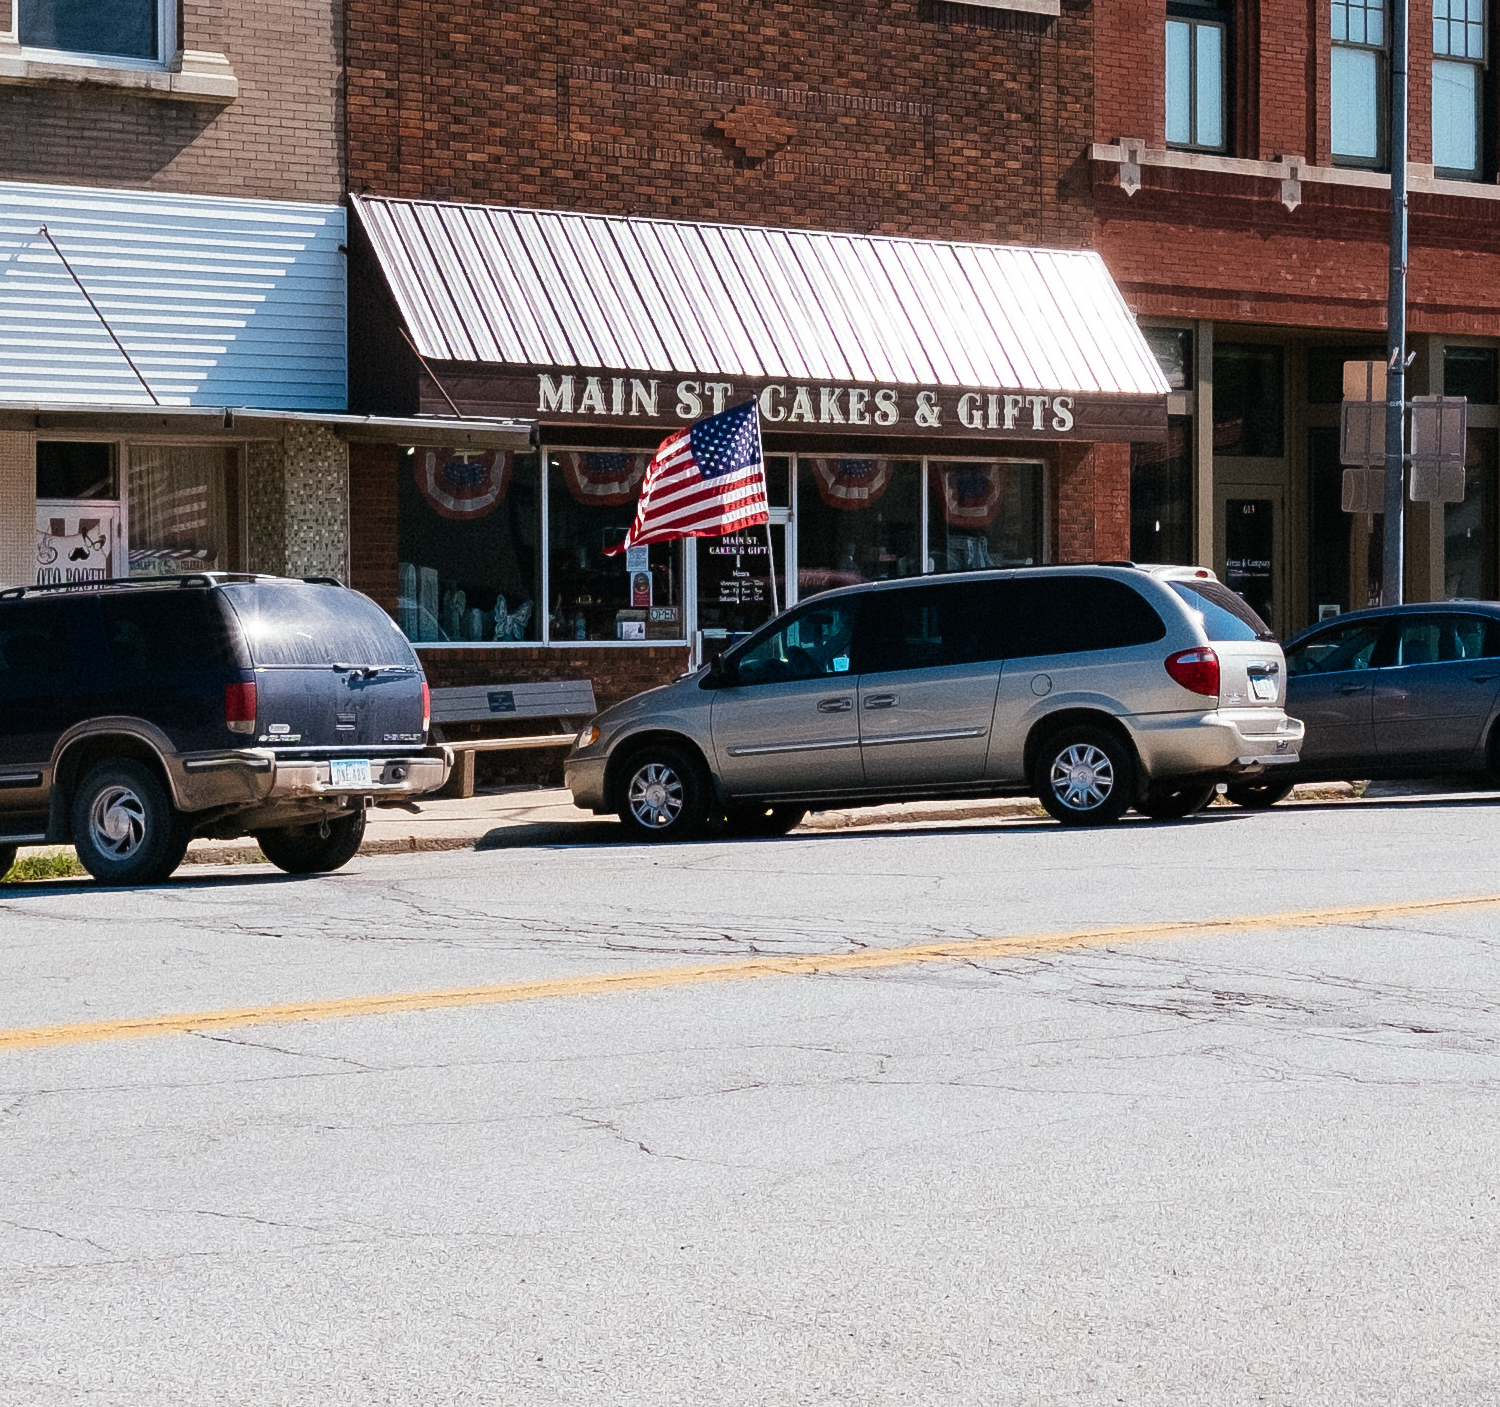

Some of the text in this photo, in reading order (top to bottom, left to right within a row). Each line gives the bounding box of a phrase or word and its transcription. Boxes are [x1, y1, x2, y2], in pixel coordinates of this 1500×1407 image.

[536, 374, 660, 416] MAIN
[758, 384, 899, 426] CAKES
[914, 391, 942, 428] &
[957, 392, 1075, 432] GIFTS
[722, 536, 745, 545] MAIN
[709, 546, 737, 555] CAKES
[747, 546, 771, 555] GIFT
[651, 608, 677, 620] OPEN
